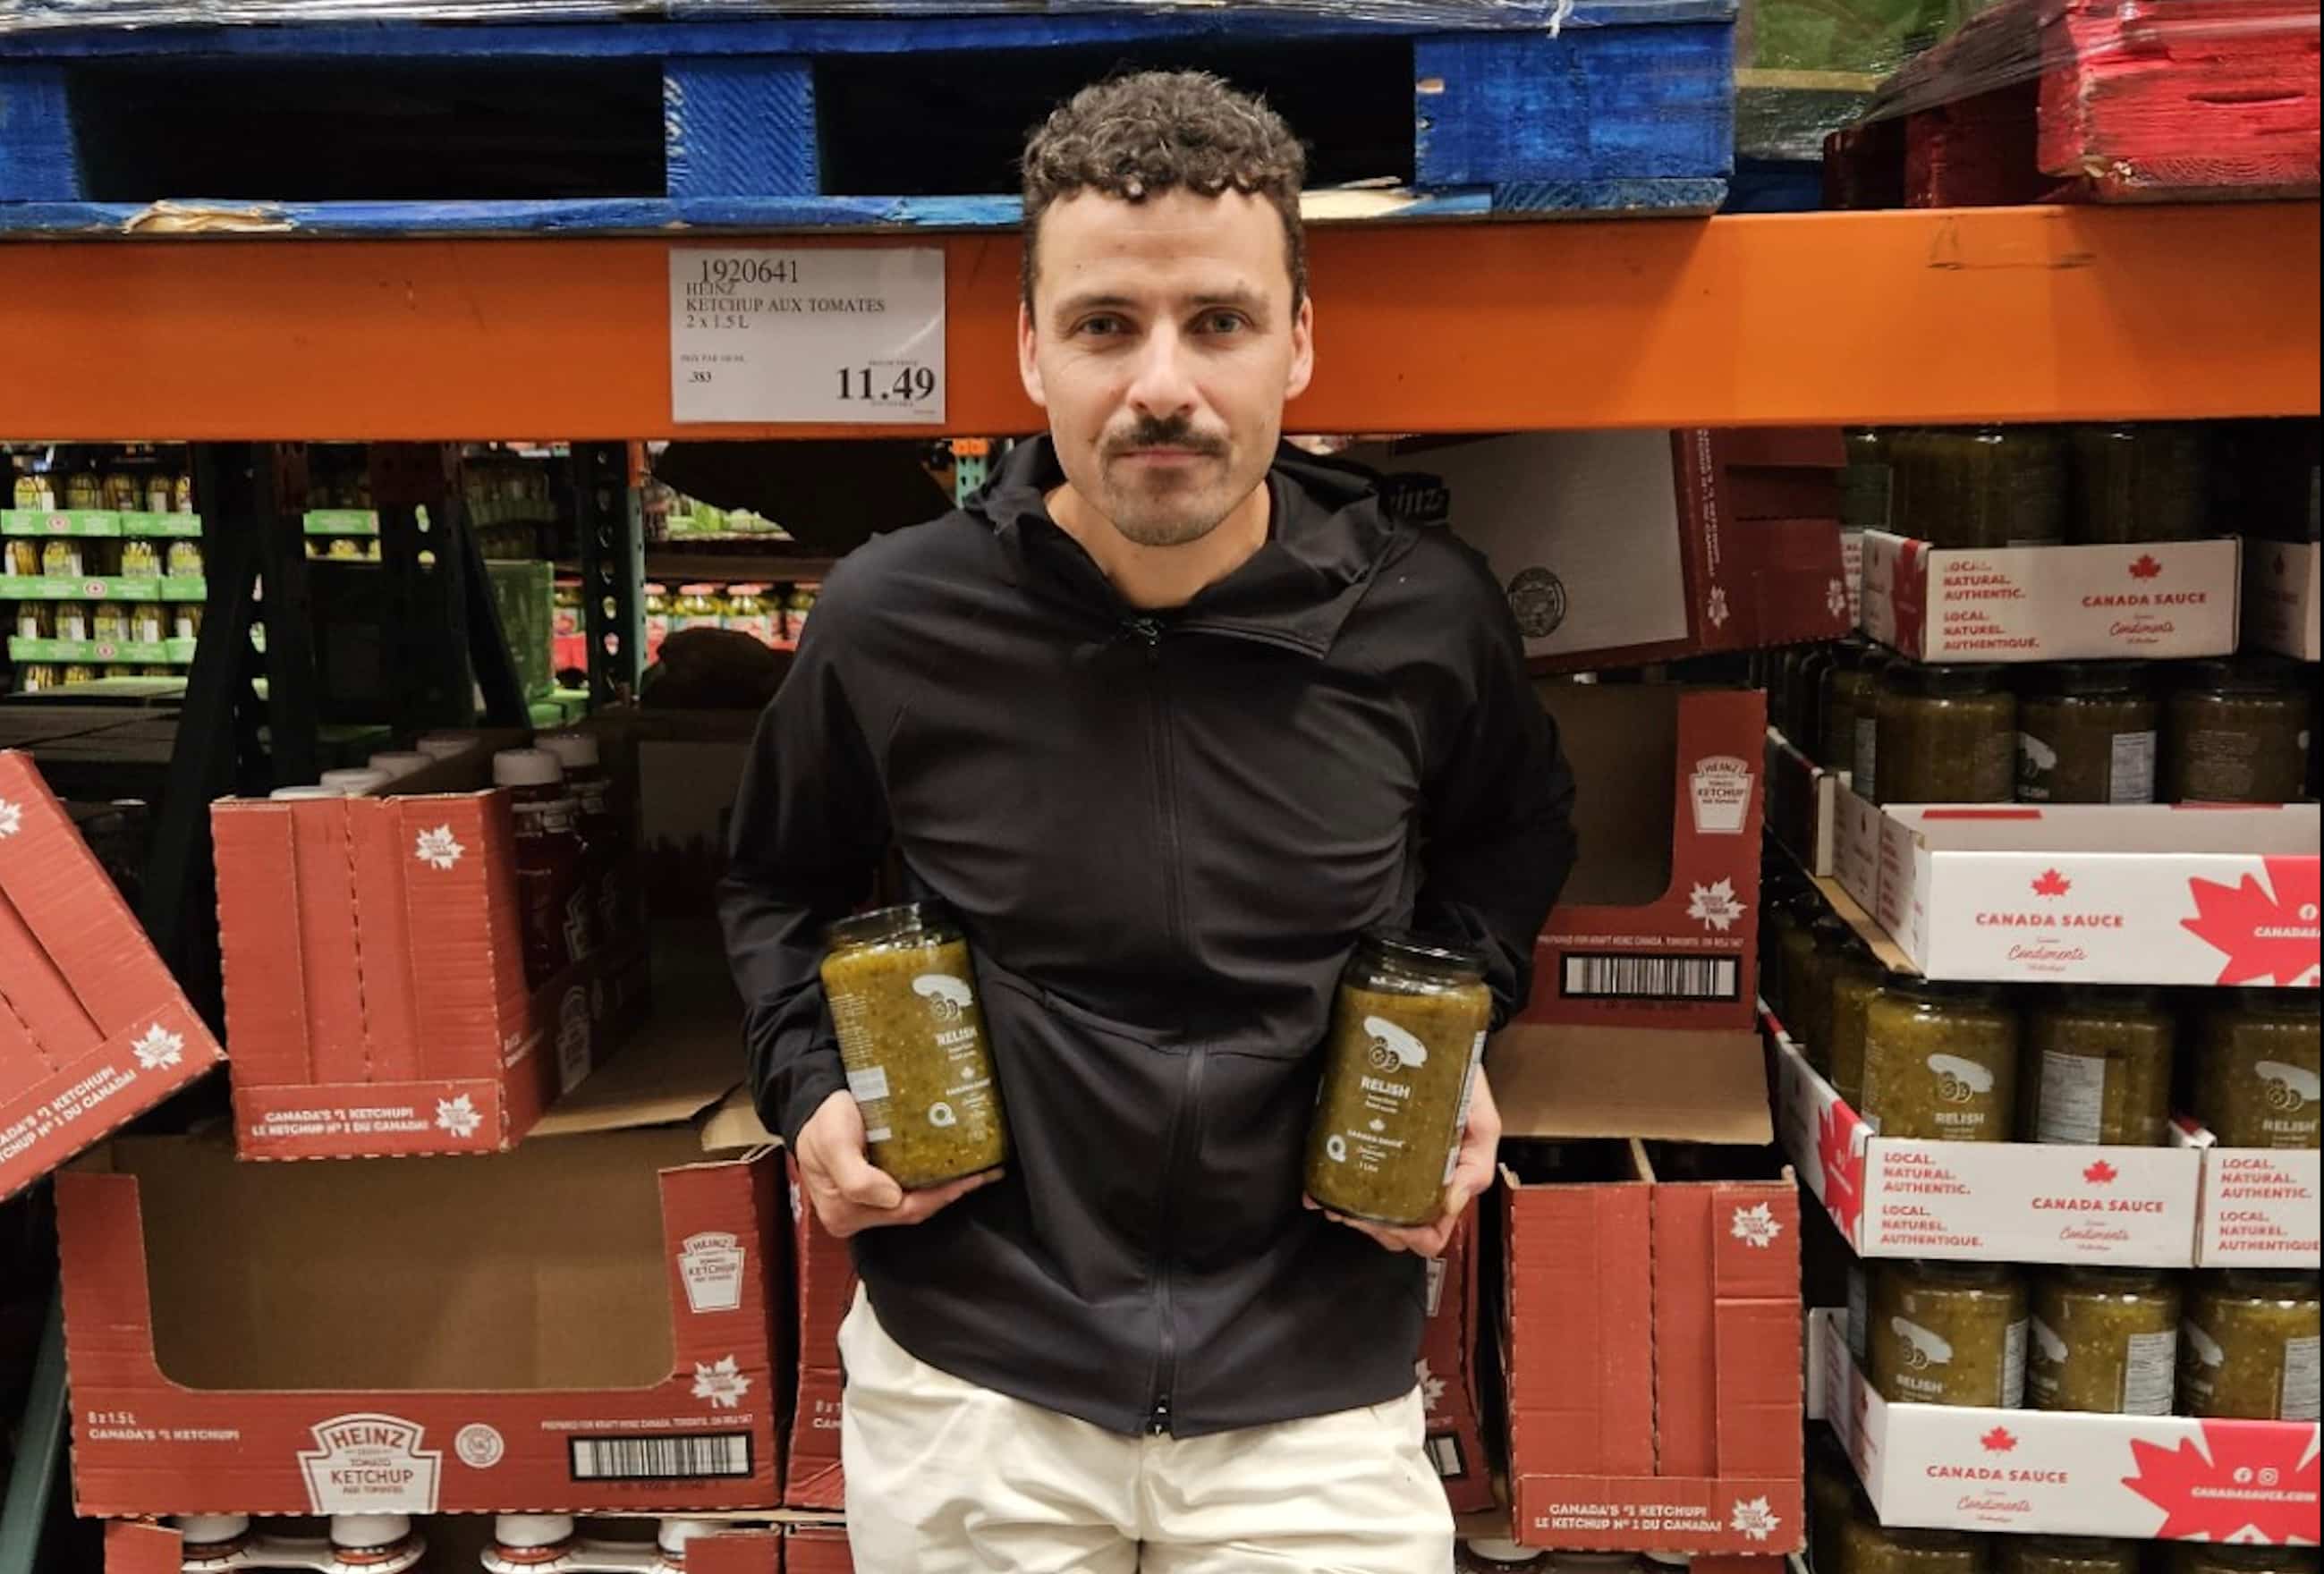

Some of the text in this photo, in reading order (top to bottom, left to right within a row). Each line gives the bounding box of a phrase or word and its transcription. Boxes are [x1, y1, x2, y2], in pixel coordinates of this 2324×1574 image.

[701, 258, 798, 283] 1920641
[686, 283, 736, 296] HEINZ
[686, 298, 886, 312] KETCHUP AUX TOMATES
[686, 315, 750, 328] 2 x 1.5 L
[837, 367, 936, 401] 11.49
[1943, 575, 2011, 587] NATURAL.
[1945, 588, 2026, 601] AUTHENTIC.
[2082, 592, 2207, 607] CANADA SAUCE
[1944, 612, 1989, 622] LOCAL.
[1943, 625, 2005, 636] NATUREL.
[1944, 638, 2040, 651] AUTHENTIQUE.
[1975, 912, 2124, 927] CANADA SAUCE
[935, 1027, 979, 1046] RELISH
[52, 1066, 116, 1111] KETCHUP!
[1361, 1075, 1411, 1099] RELISH
[63, 1106, 82, 1121] DU
[82, 1069, 137, 1109] CANADA!
[266, 1109, 331, 1122] CANADA'S
[349, 1107, 413, 1120] KETCHUP!
[1934, 1113, 1985, 1125] RELISH
[251, 1124, 267, 1137] LE
[268, 1123, 325, 1136] KETCHUP
[344, 1121, 352, 1134] 1
[353, 1121, 370, 1133] DU
[373, 1120, 428, 1131] CANADA!
[2262, 1120, 2317, 1132] RELISH
[1884, 1152, 1935, 1164] LOCAL.
[2222, 1159, 2275, 1169] LOCAL.
[1883, 1167, 1955, 1180] NATURAL.
[2221, 1173, 2297, 1183] NATURAL.
[1883, 1181, 1972, 1195] AUTHENTIC.
[2221, 1188, 2311, 1198] AUTHENTIC.
[1882, 1205, 1931, 1216] LOCAL.
[2031, 1197, 2164, 1213] CANADA SAUCE
[2220, 1212, 2269, 1222] LOCAL.
[1881, 1220, 1947, 1231] NATUREL.
[2220, 1226, 2287, 1236] NATUREL.
[1880, 1234, 1984, 1247] AUTHENTIQUE.
[1896, 1374, 1943, 1392] RELISH
[89, 1428, 157, 1441] CANADA'S
[173, 1429, 240, 1441] KETCHUP!
[330, 1427, 406, 1449] HEINZ
[330, 1469, 414, 1485] KETCHUP
[1926, 1466, 2069, 1484] CANADA SAUCE
[2191, 1486, 2317, 1502] CANADASAUCE.COM
[1549, 1503, 1619, 1516] CANADA'S
[1639, 1505, 1708, 1518] KETCHUP!
[1535, 1517, 1549, 1528] LE
[1552, 1518, 1610, 1529] KETCHUP
[1633, 1519, 1641, 1530] 1
[1641, 1519, 1659, 1530] DU
[1663, 1520, 1723, 1532] CANADA!
